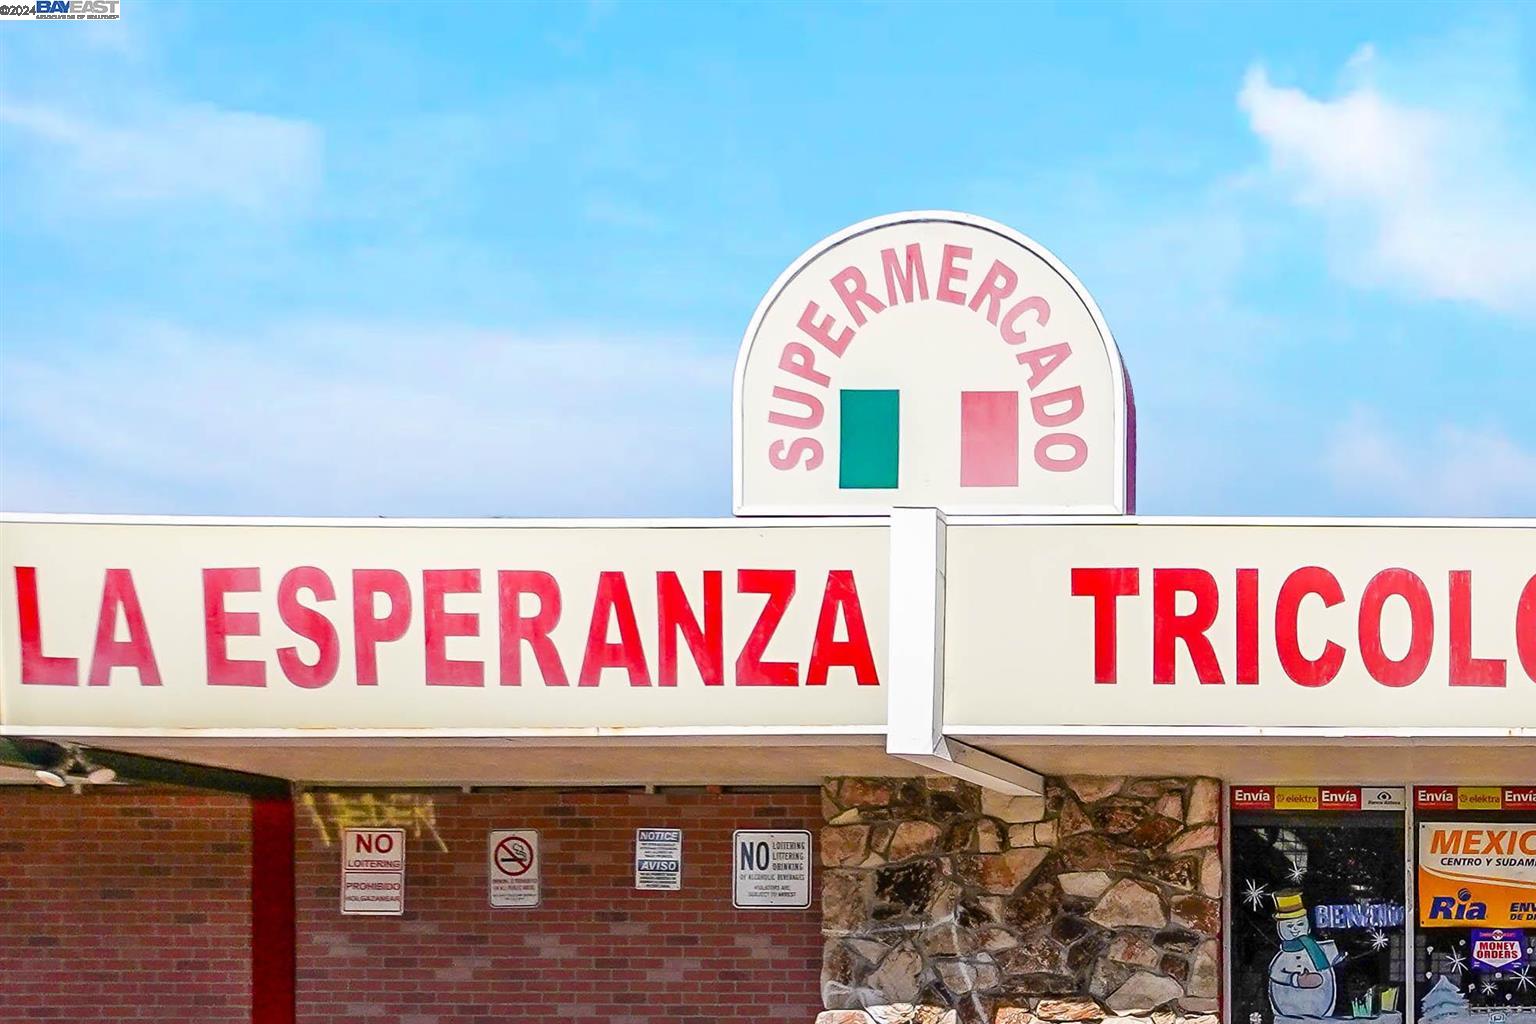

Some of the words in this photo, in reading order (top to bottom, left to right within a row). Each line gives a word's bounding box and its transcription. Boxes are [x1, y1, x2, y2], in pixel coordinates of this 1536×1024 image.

[768, 243, 1088, 472] SUPERMERCADO
[14, 566, 163, 687] LA
[202, 565, 881, 688] ESPERANZA
[1235, 789, 1270, 801] Envía
[1286, 794, 1318, 802] elektra
[1322, 790, 1357, 802] Envía
[1418, 790, 1453, 802] Envía
[1469, 794, 1500, 802] elektra
[640, 832, 678, 840] NOTICE
[356, 834, 393, 853] NO
[741, 842, 769, 870] NO
[772, 852, 803, 860] LITTERING
[641, 861, 676, 870] AVISO
[1441, 858, 1482, 866] CENTRO
[1486, 858, 1493, 866] Y
[1429, 888, 1487, 920] Ria
[1479, 942, 1515, 950] MONEY
[1477, 951, 1518, 959] ORDERS
